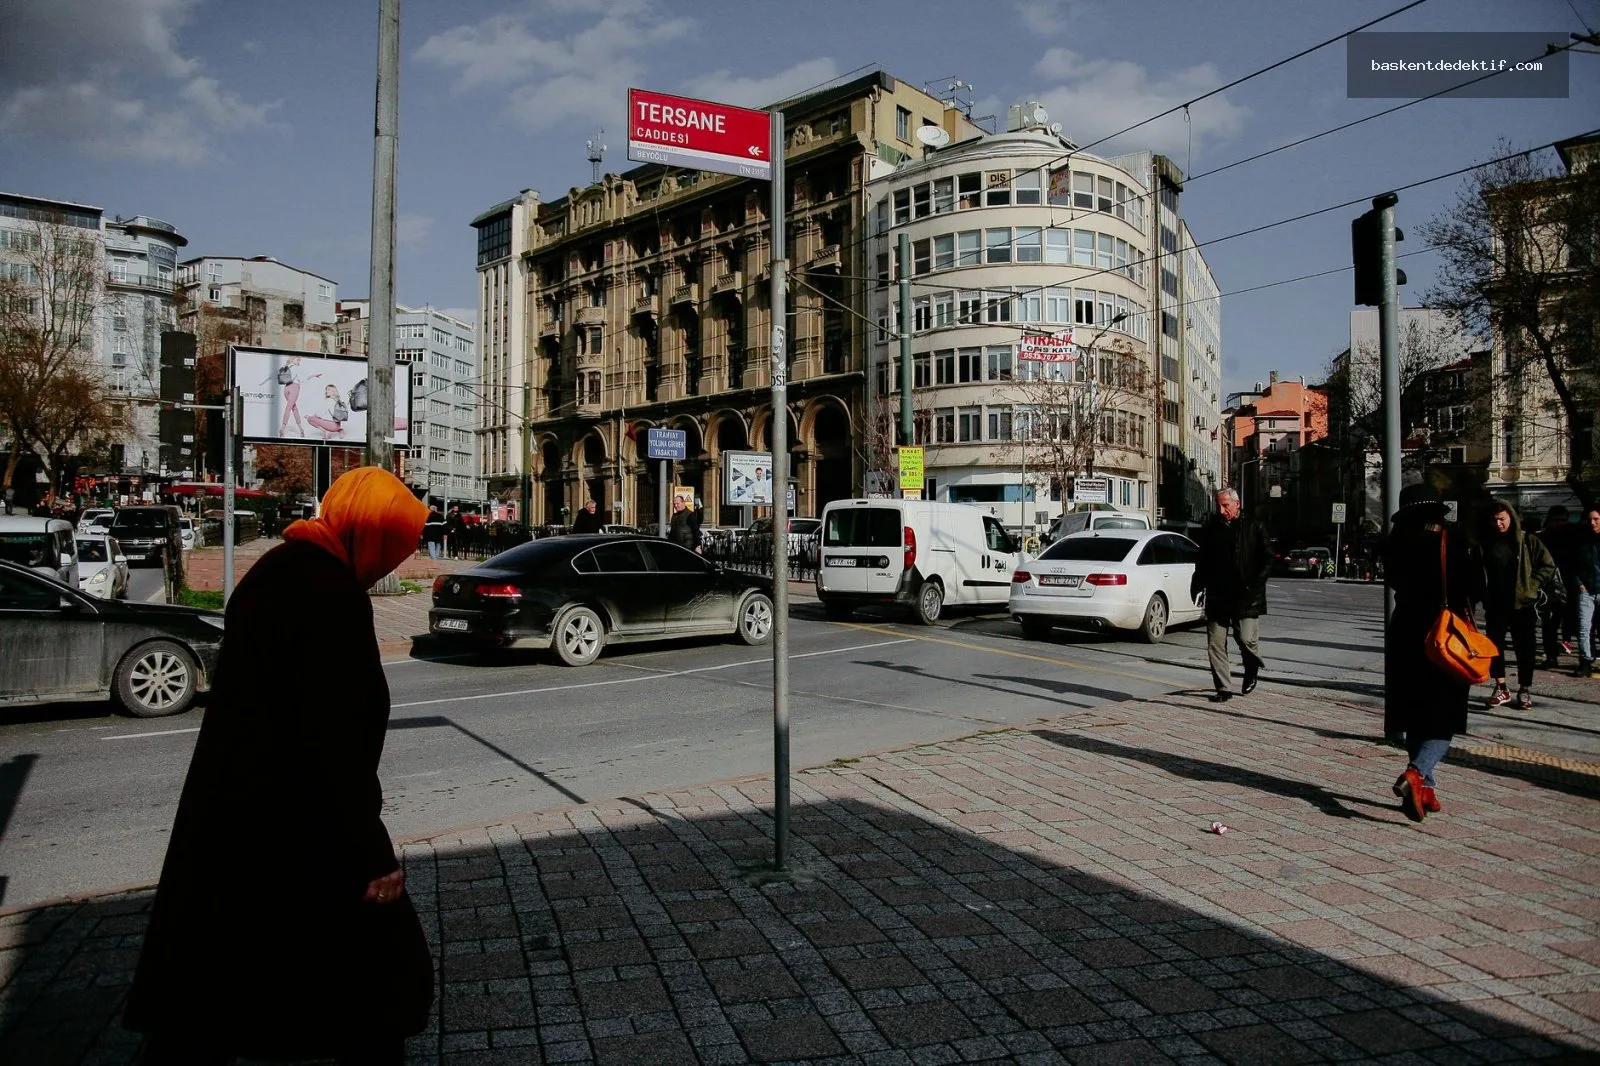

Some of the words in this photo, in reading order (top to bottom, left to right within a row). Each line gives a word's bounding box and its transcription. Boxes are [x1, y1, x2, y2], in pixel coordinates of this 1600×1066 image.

[637, 101, 726, 134] TERSANE
[637, 127, 689, 145] CADDESİ
[650, 439, 667, 447] YOLUNA
[655, 449, 678, 457] YASAKTIR
